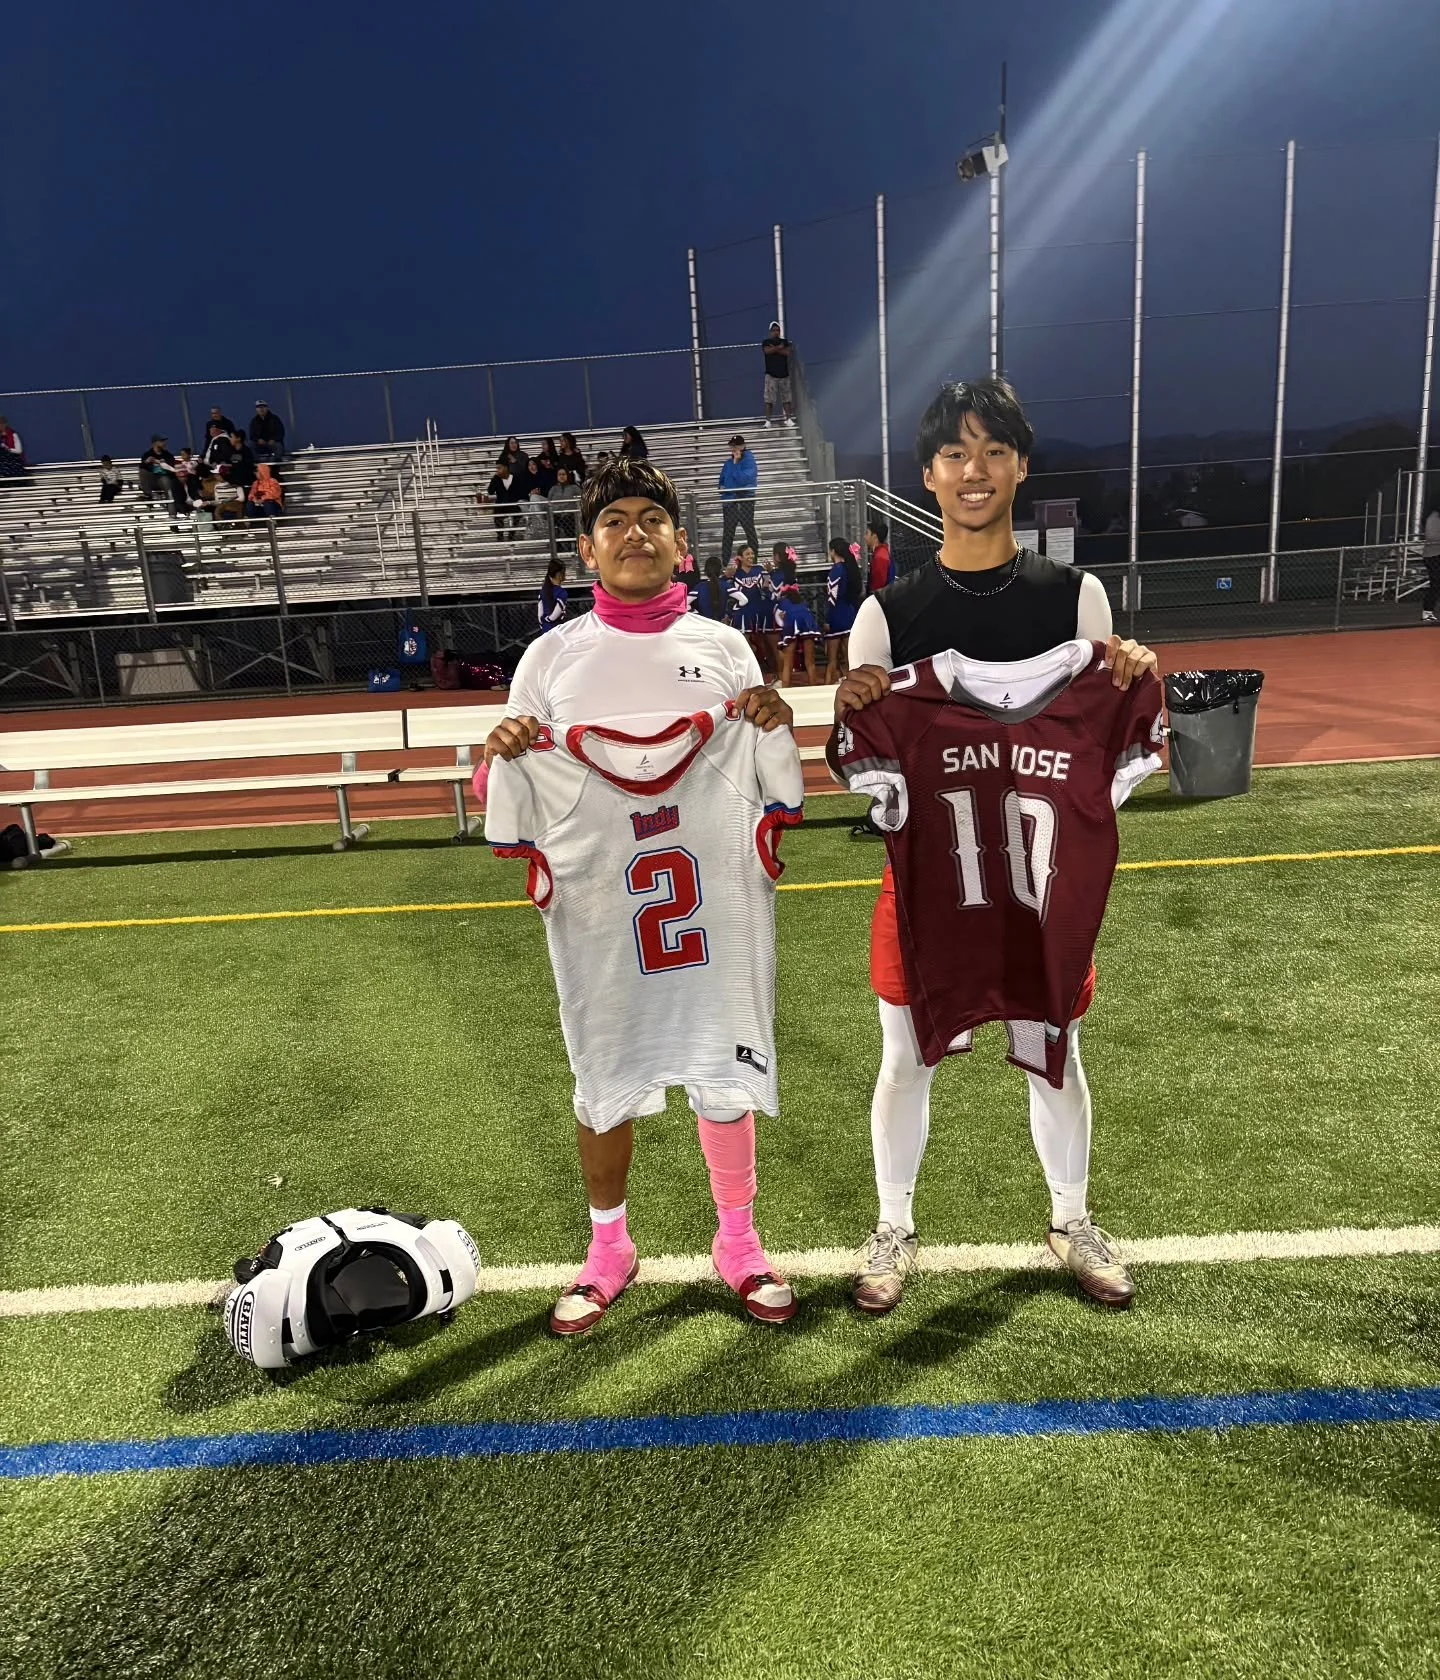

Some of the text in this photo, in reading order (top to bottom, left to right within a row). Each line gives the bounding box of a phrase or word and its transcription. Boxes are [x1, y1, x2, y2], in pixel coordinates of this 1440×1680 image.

[943, 743, 999, 773] SAN
[625, 846, 709, 975] 2
[935, 785, 1059, 928] 10
